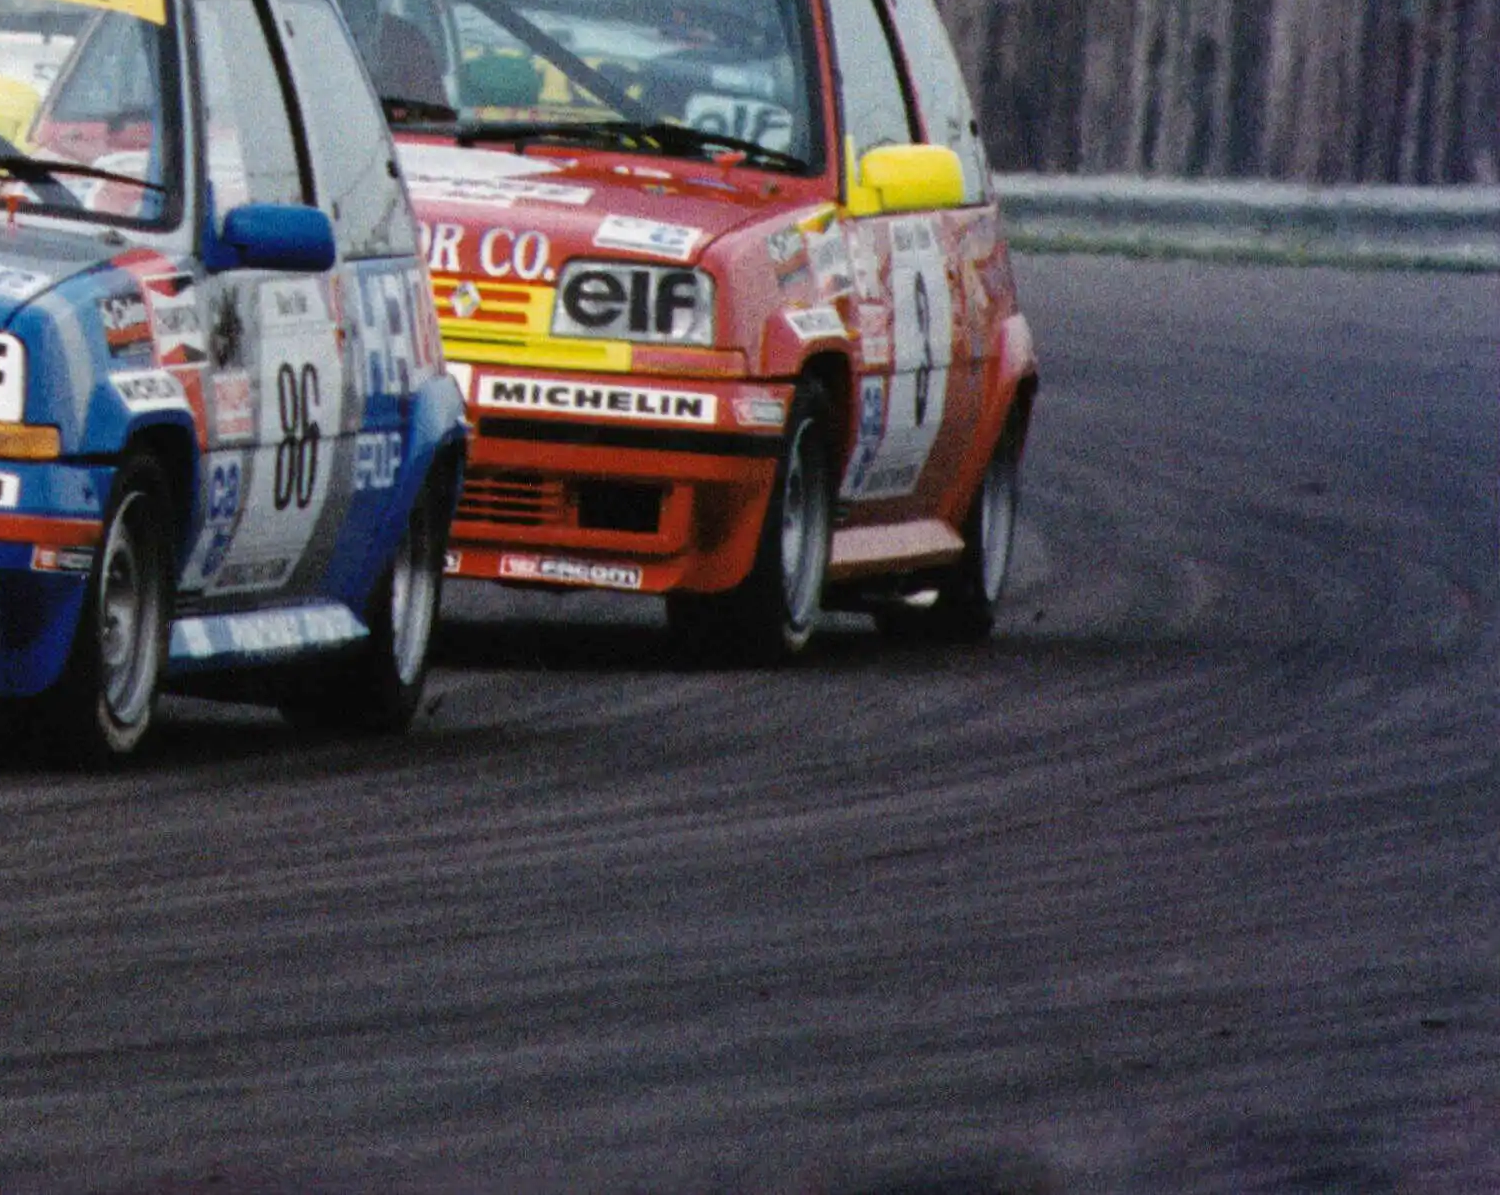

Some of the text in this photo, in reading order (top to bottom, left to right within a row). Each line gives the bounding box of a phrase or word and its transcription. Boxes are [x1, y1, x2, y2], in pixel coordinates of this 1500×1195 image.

[479, 226, 556, 281] CO.
[561, 269, 698, 336] elf
[491, 380, 705, 419] MICHELIN
[274, 361, 322, 511] 86
